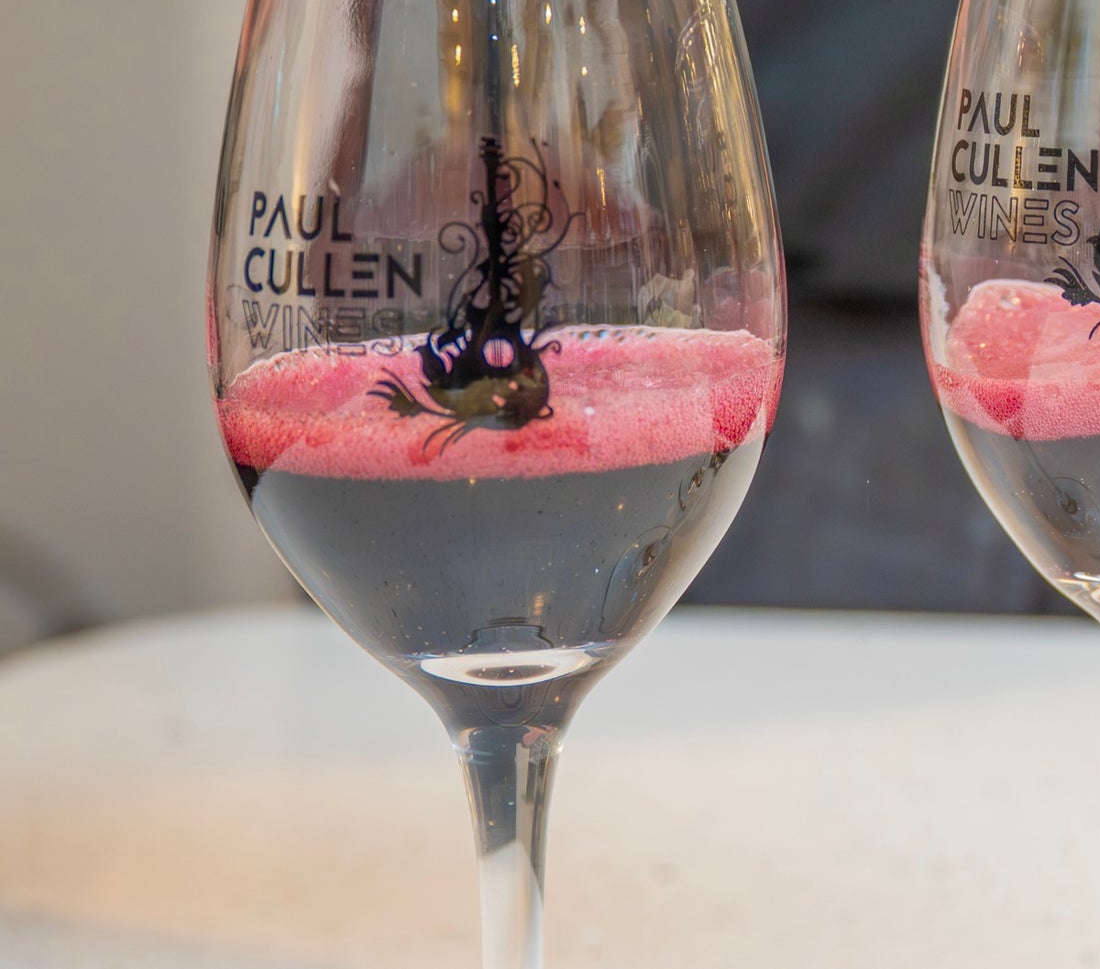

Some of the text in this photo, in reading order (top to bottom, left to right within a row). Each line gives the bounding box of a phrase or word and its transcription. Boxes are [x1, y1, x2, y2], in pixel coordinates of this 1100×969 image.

[956, 88, 1041, 138] PAUL
[951, 139, 1099, 193] CULLEN
[249, 190, 353, 242] PAUL
[949, 188, 1081, 246] WINES
[244, 246, 423, 299] CULLEN
[242, 299, 404, 357] WINES
